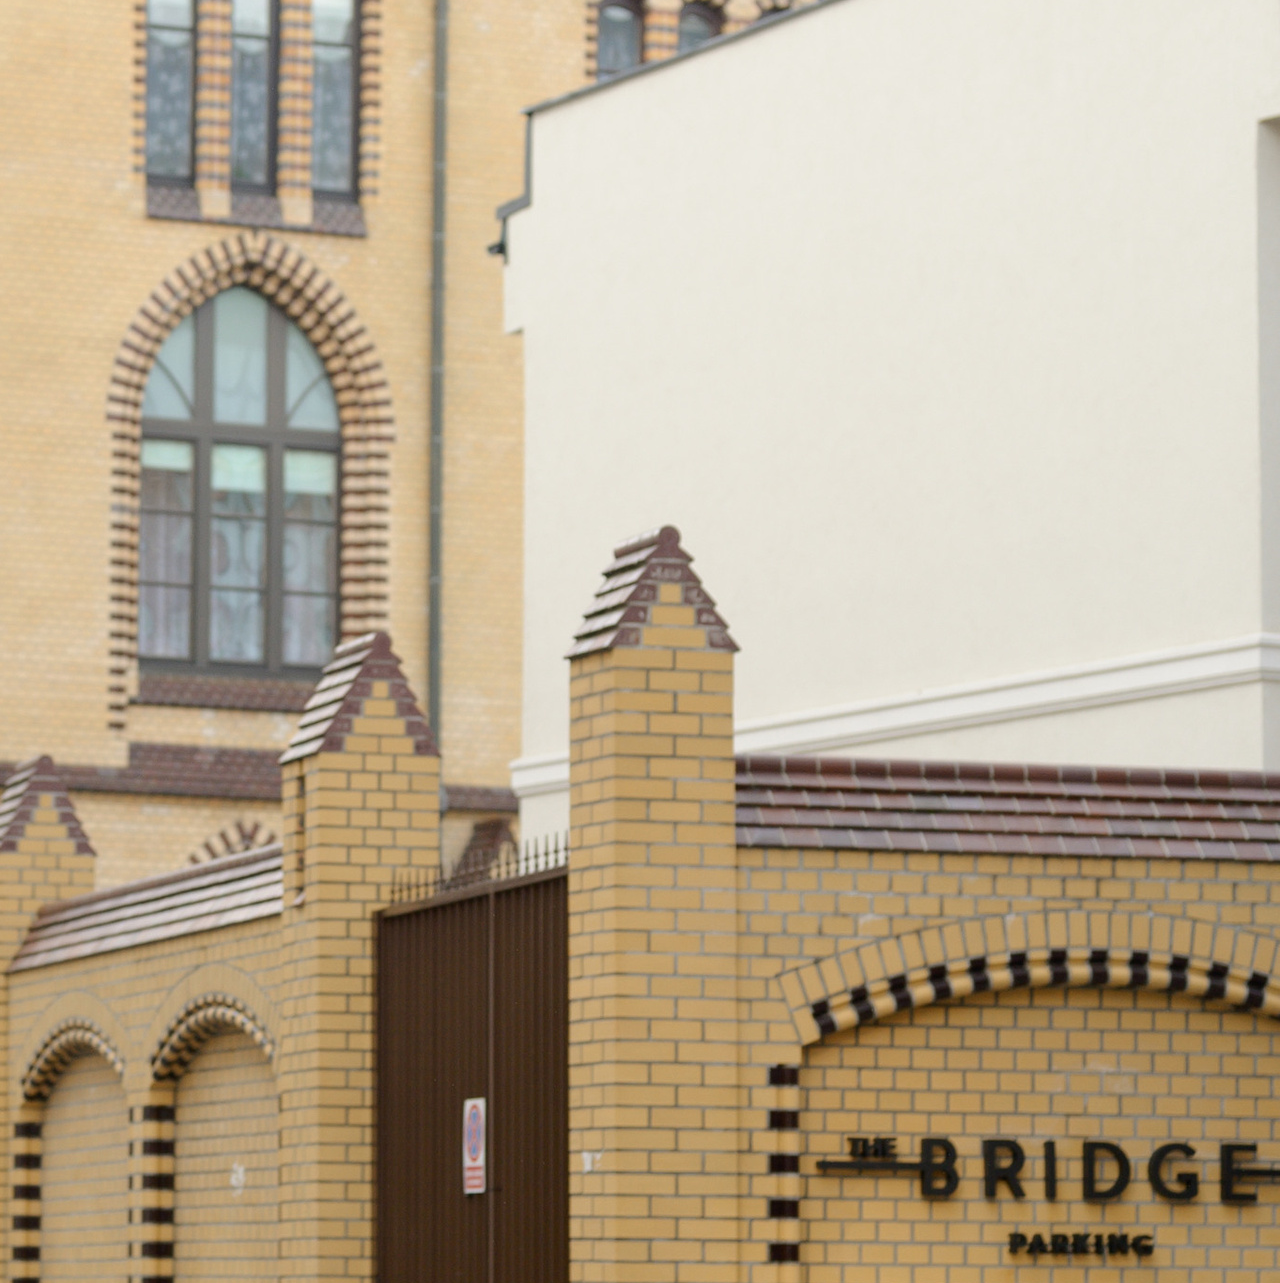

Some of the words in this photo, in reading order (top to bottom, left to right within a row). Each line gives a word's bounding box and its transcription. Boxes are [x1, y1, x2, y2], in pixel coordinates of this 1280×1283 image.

[847, 1136, 897, 1158] THE
[921, 1137, 1258, 1204] BRIDGE
[1008, 1233, 1154, 1256] PARKING
